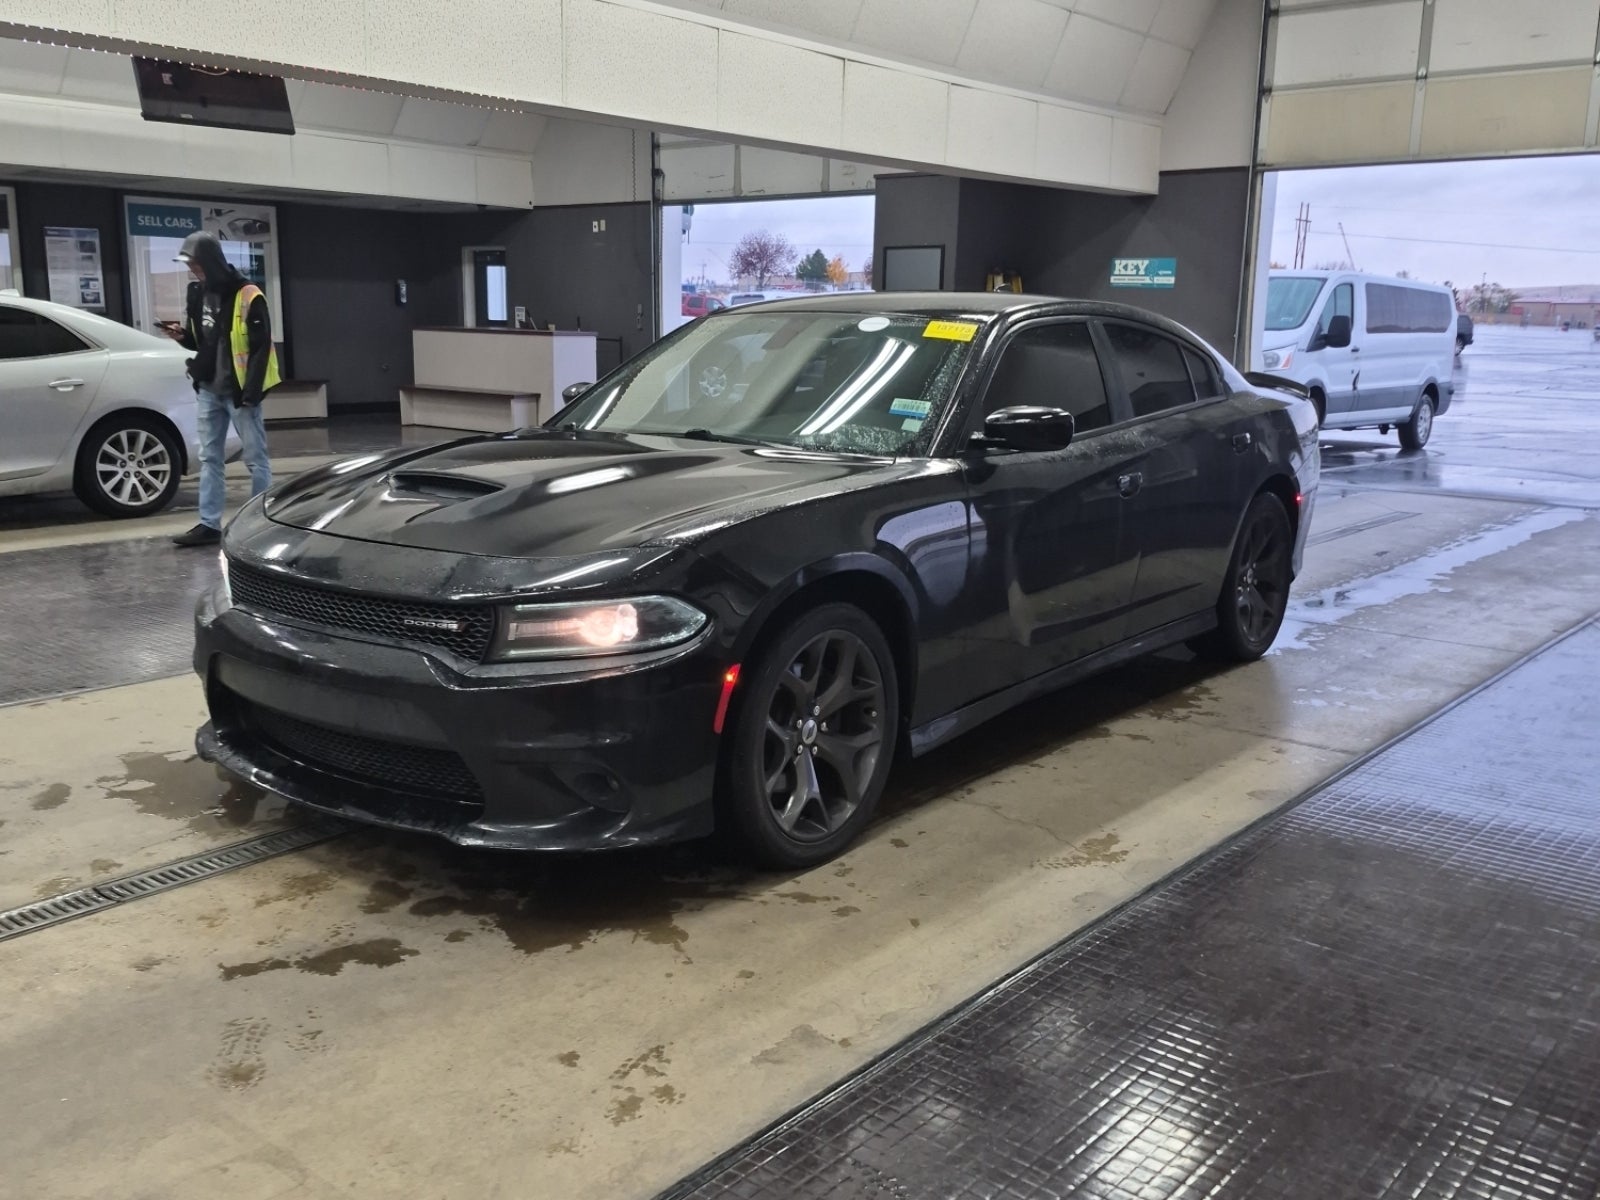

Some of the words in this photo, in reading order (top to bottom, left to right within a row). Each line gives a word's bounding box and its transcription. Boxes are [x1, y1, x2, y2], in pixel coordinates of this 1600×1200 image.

[137, 215, 162, 226] SELL
[1113, 259, 1149, 275] KEY
[404, 620, 458, 629] DODGE
